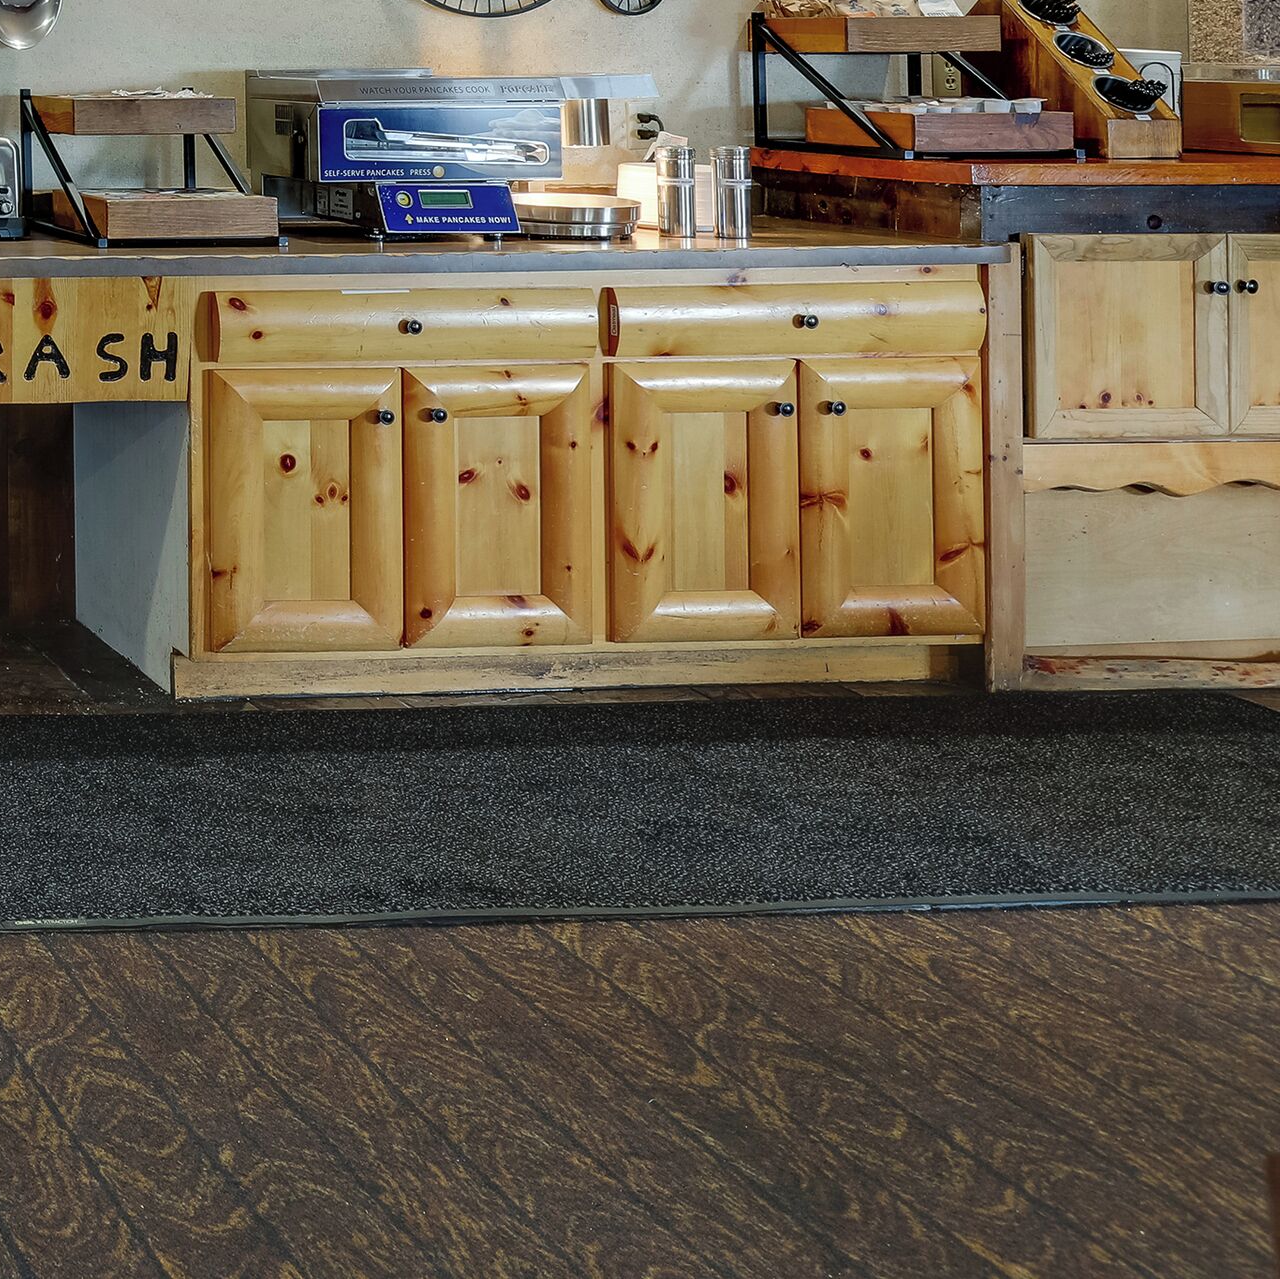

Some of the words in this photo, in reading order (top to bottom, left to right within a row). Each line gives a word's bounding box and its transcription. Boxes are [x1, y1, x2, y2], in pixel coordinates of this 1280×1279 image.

[359, 86, 391, 95] WATCH
[392, 86, 418, 95] YOUR
[419, 86, 464, 94] PANCAKES
[465, 85, 490, 94] COOK
[366, 169, 405, 177] PANCAKES
[416, 216, 440, 224] MAKE
[441, 216, 487, 224] PANCAKES
[488, 216, 512, 224] NOW!
